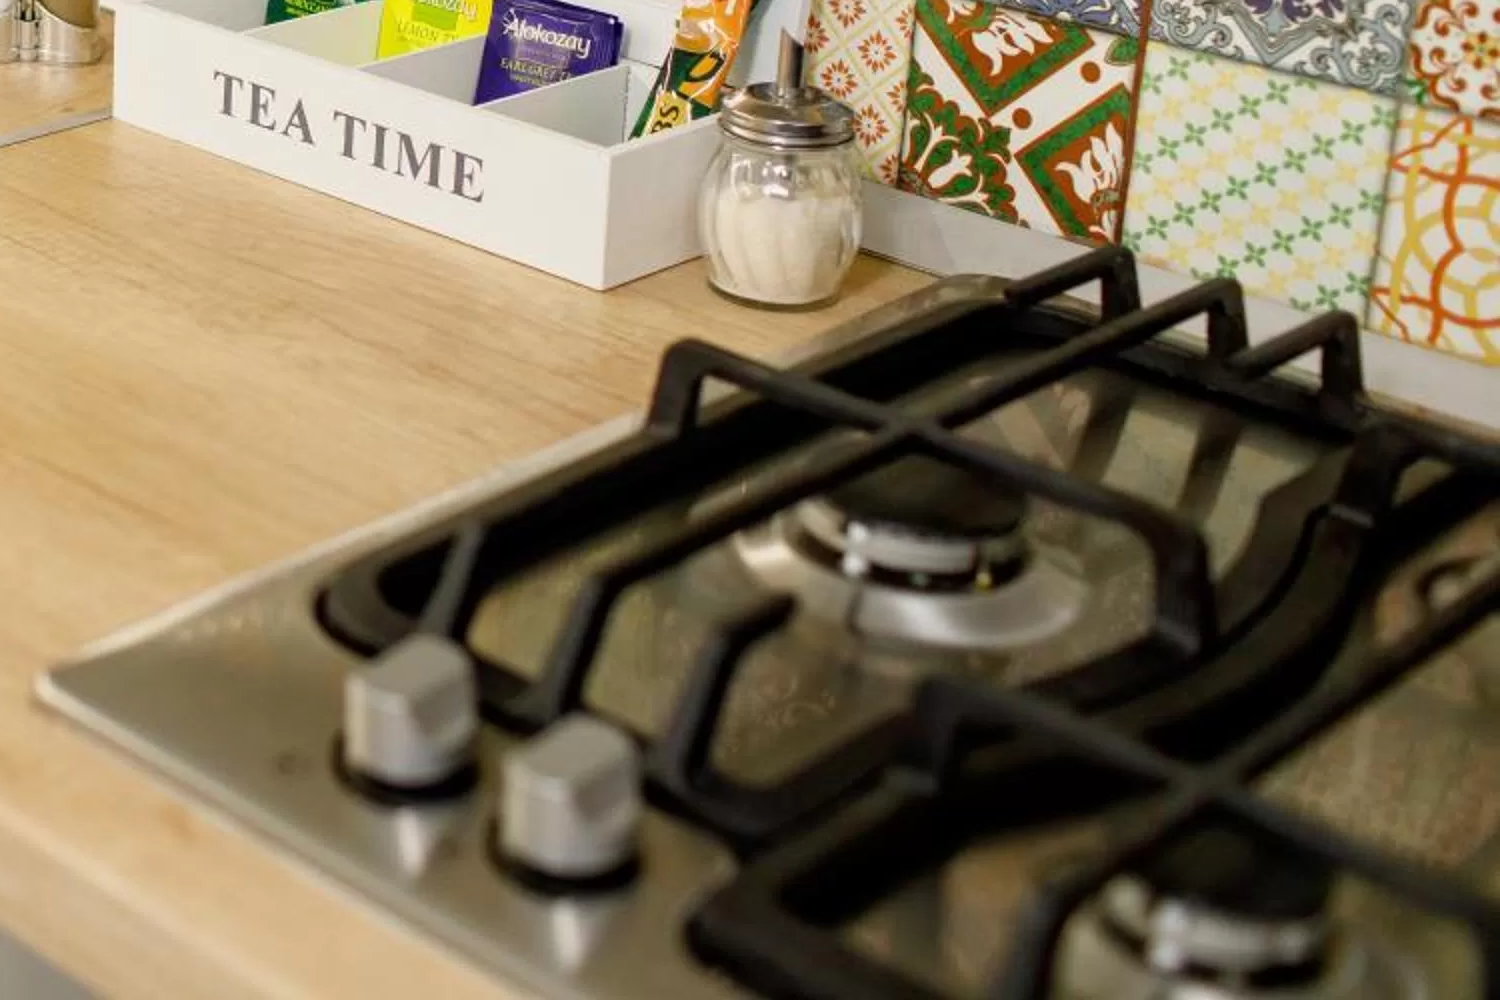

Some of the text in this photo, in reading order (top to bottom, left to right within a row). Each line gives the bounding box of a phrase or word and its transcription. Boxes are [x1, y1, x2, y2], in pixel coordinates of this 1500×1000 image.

[502, 8, 592, 59] Alokozay
[213, 70, 485, 203] TEA TIME
